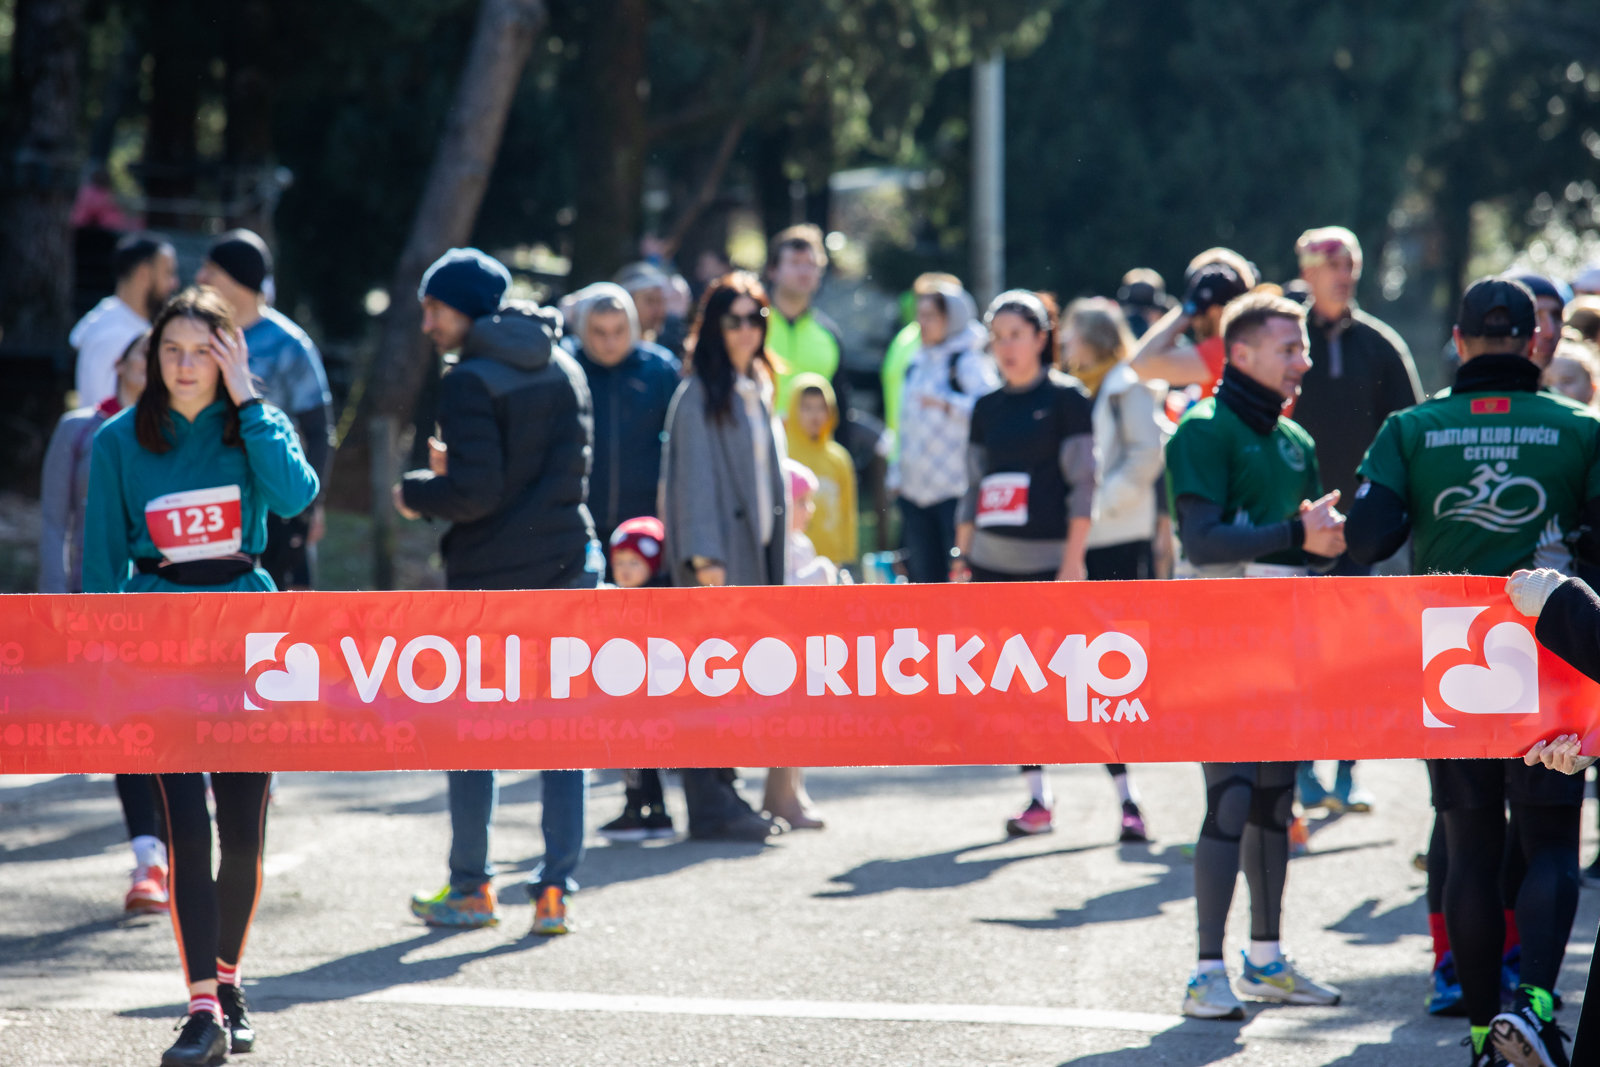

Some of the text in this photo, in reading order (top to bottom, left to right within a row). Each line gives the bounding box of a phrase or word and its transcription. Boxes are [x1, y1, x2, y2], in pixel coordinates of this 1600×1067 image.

[1425, 427, 1479, 449] TRIATLON
[1480, 426, 1512, 444] KLUB
[1463, 445, 1519, 461] CETINJE
[166, 505, 225, 537] 123
[93, 612, 144, 632] VOLI
[339, 634, 522, 704] VOLI
[550, 627, 1049, 698] PODGORIČKA
[1047, 631, 1148, 723] 10
[1091, 697, 1150, 723] KM
[0, 720, 118, 746] ORIČKA
